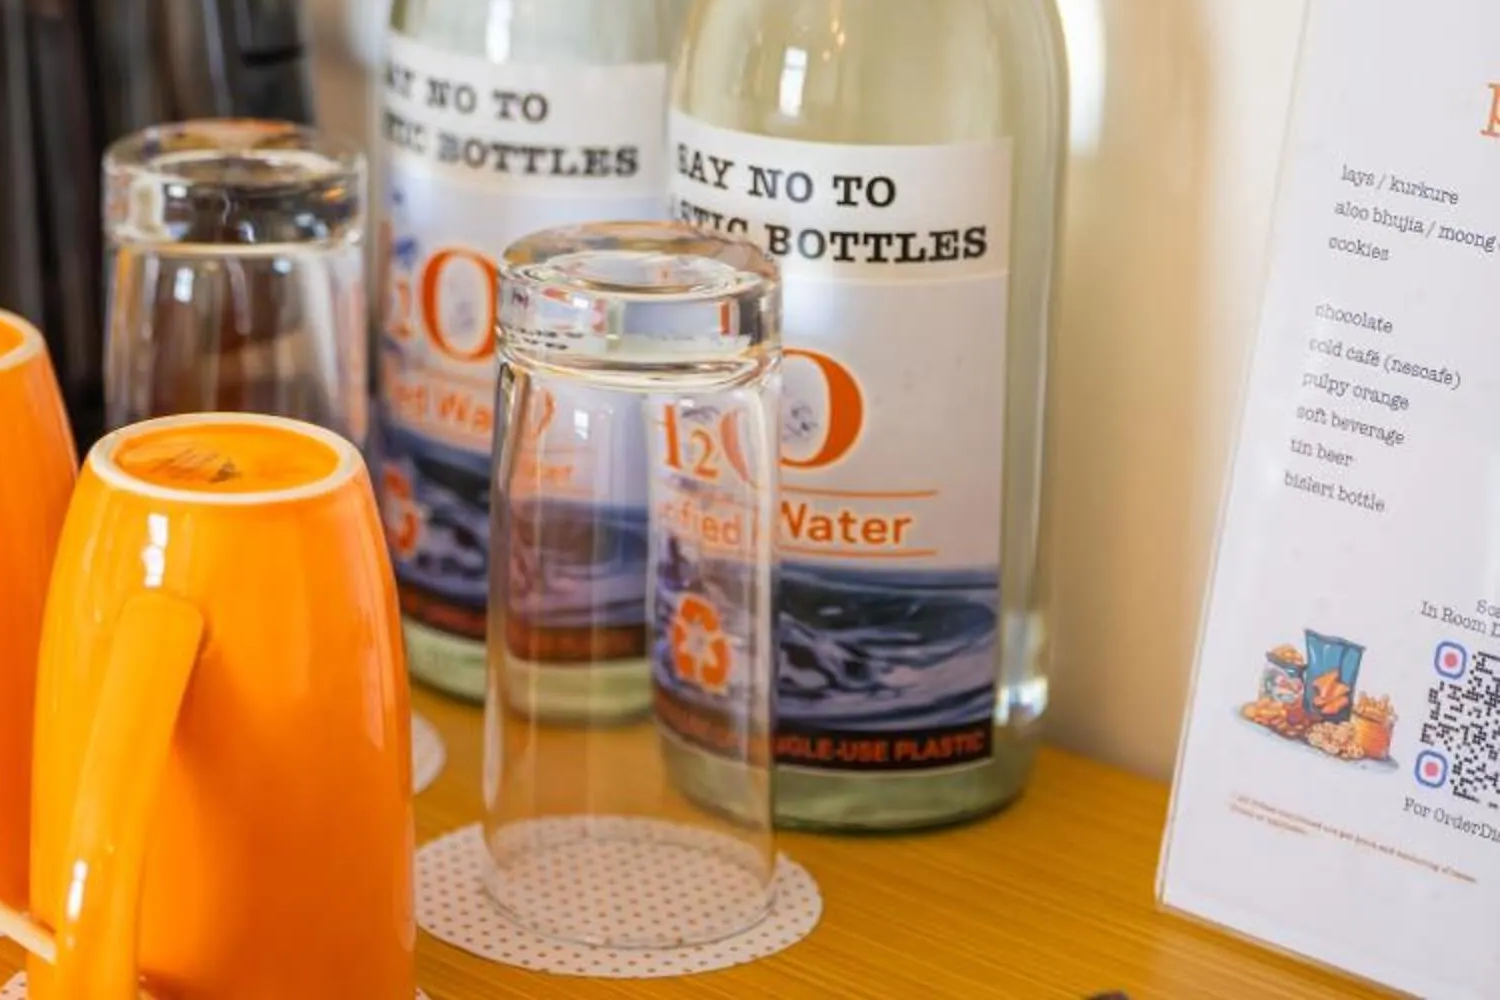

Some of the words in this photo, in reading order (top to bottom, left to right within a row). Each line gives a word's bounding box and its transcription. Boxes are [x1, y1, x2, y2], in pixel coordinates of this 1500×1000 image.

[426, 76, 477, 114] NO
[492, 89, 549, 124] TO
[437, 132, 640, 179] BOTTLES
[747, 165, 814, 204] NO
[832, 174, 897, 208] TO
[1340, 163, 1375, 187] lays
[1388, 175, 1460, 205] kurkure
[764, 224, 988, 264] BOTTLES
[1334, 200, 1370, 221] aloo
[1372, 207, 1425, 233] bhujia
[1438, 223, 1496, 253] moong
[1328, 235, 1390, 261] cookies
[1315, 303, 1394, 334] chocolate
[1308, 338, 1343, 358] cold
[1302, 371, 1350, 398] pulpy
[1352, 386, 1410, 411] orange
[1296, 405, 1328, 425] soft
[1331, 411, 1405, 447] beverage
[1290, 437, 1313, 457] tin
[1317, 442, 1354, 468] beer
[1284, 469, 1335, 499] bisleri
[1338, 485, 1386, 513] bottle
[1420, 600, 1437, 619] In
[1441, 606, 1486, 634] Room
[894, 730, 985, 763] PLASTIC
[1402, 796, 1431, 817] For
